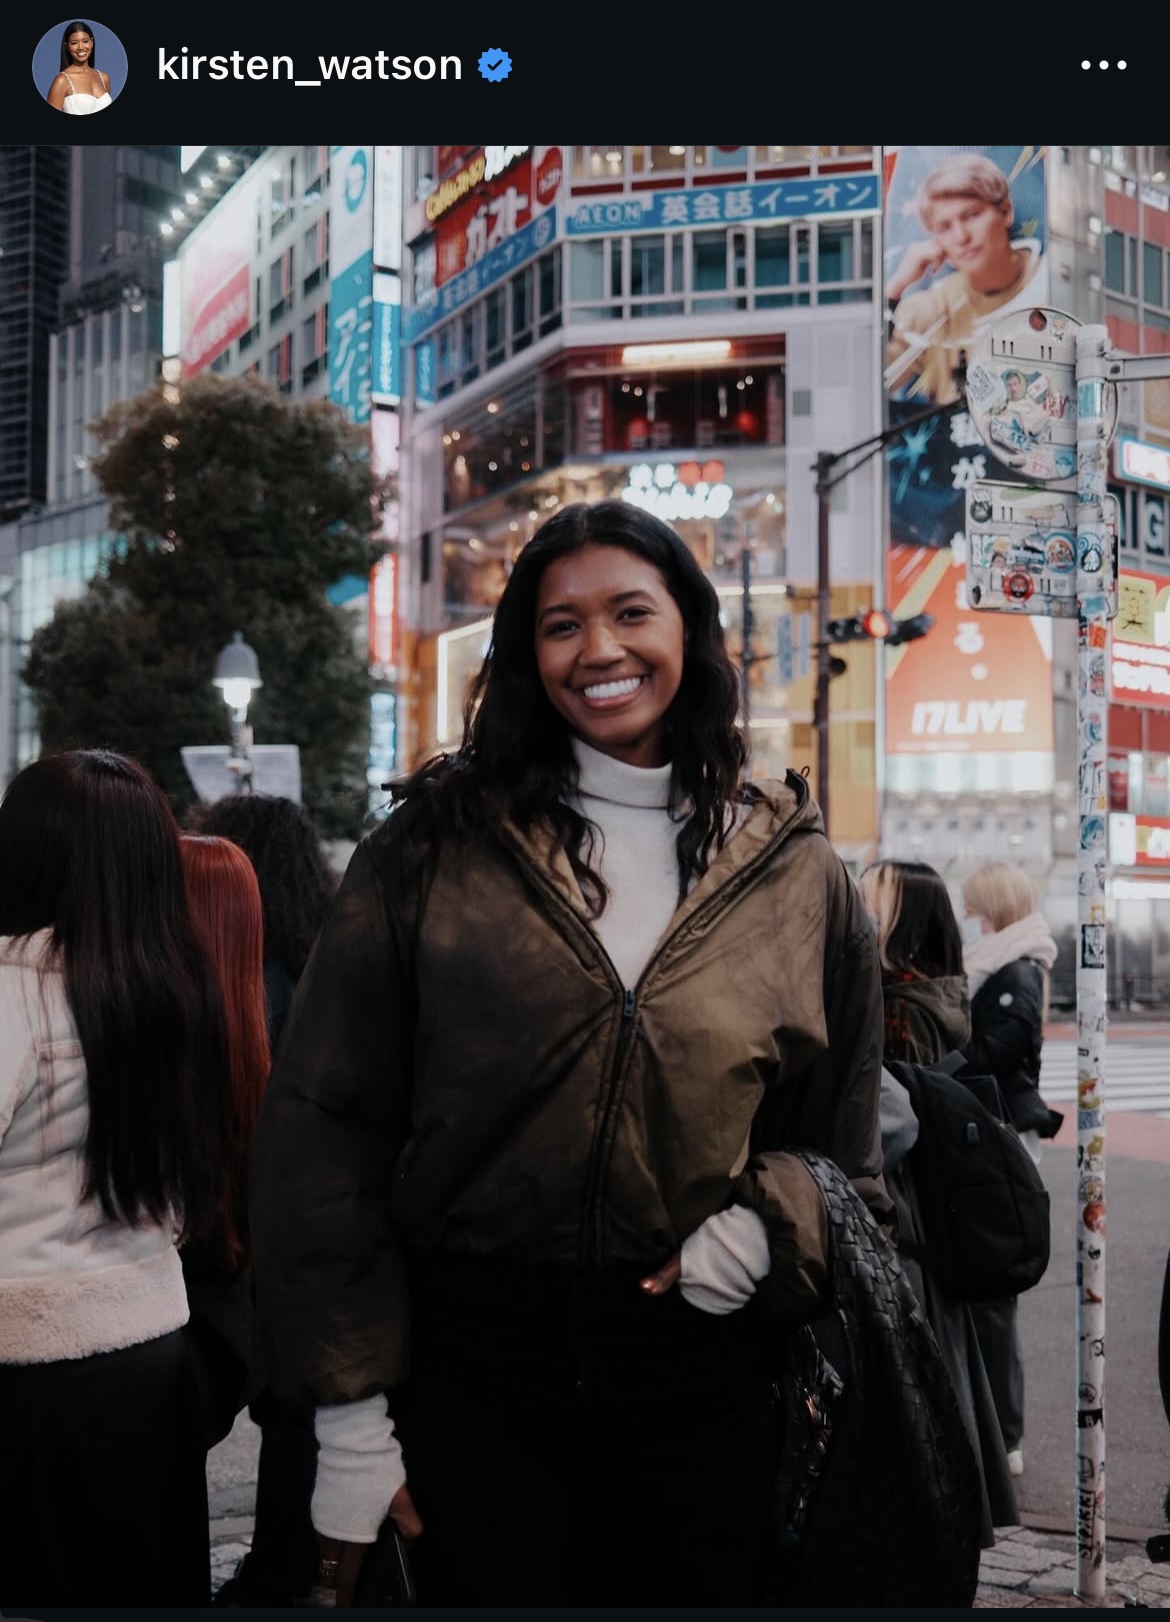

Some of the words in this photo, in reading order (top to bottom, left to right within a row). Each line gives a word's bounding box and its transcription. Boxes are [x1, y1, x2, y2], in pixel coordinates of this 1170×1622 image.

[660, 181, 871, 226] 英会話イーオン
[912, 699, 1025, 735] 17LIVE
